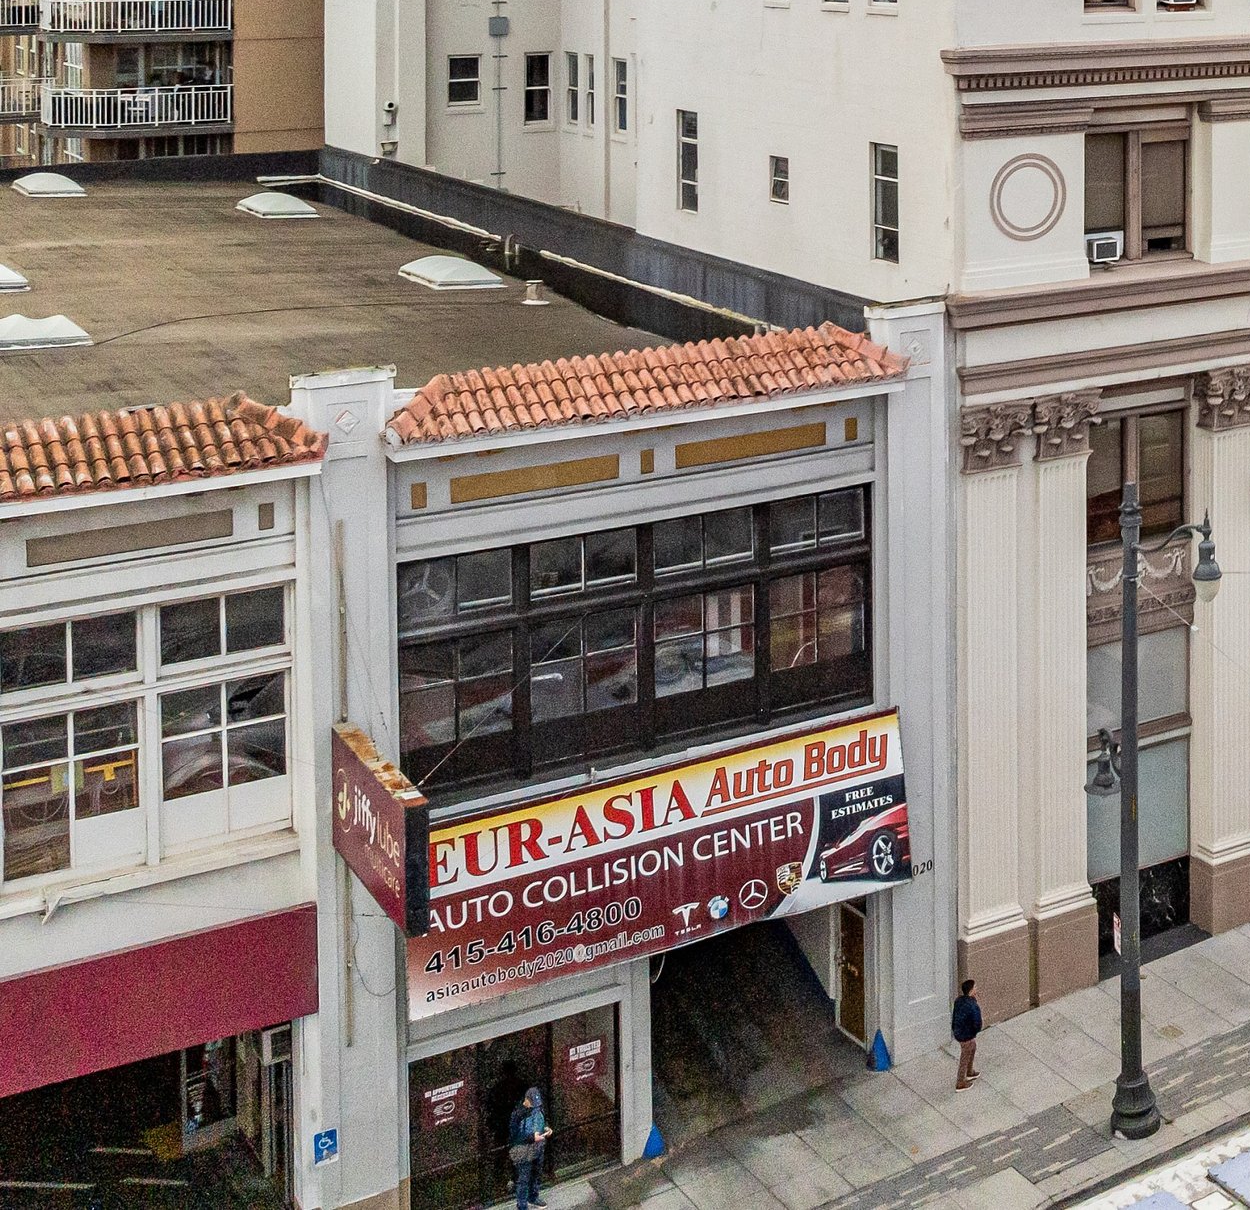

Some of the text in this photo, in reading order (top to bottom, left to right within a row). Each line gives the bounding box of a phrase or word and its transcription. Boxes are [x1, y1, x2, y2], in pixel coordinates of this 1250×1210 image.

[429, 729, 888, 888] EUR-ASIA Auto Body
[831, 794, 893, 820] ESTIMATES
[845, 786, 874, 802] FREE
[423, 811, 804, 936] AUTO COLLISION CENTER
[424, 896, 642, 975] 415-416-4800
[425, 923, 665, 1002] asiaautobody2020@gmail.com
[675, 924, 702, 936] TESLA
